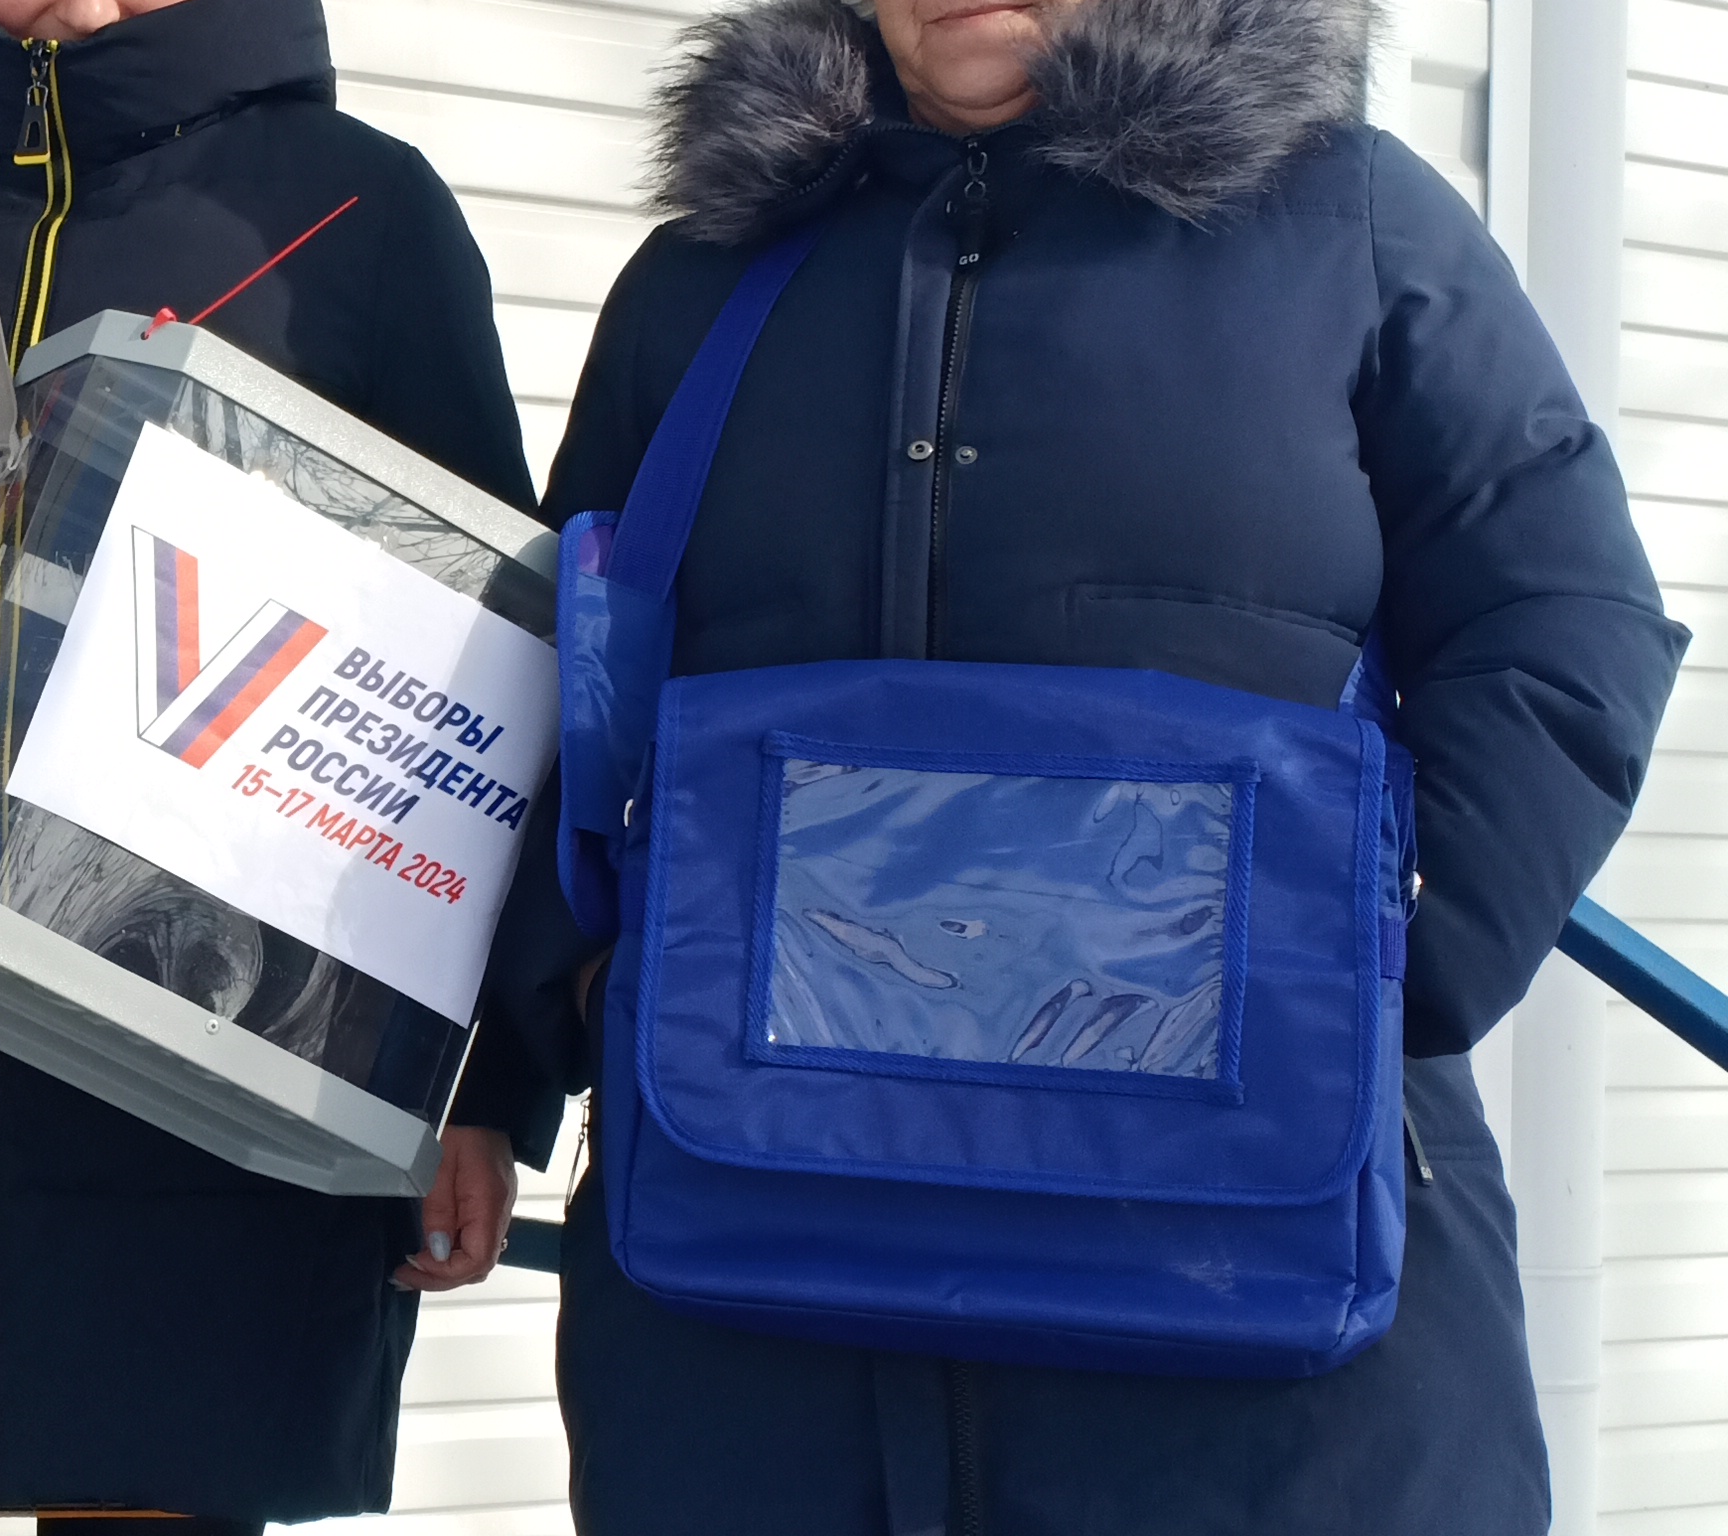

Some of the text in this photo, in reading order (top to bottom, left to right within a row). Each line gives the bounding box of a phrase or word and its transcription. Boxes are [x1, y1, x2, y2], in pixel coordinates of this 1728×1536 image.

[333, 646, 504, 755] ВЫБОРЫ
[260, 725, 420, 824] РОССИИ
[297, 685, 532, 831] ПРЕЗИДЕНТА
[306, 806, 404, 873] МАРТА
[397, 853, 467, 905] 2024
